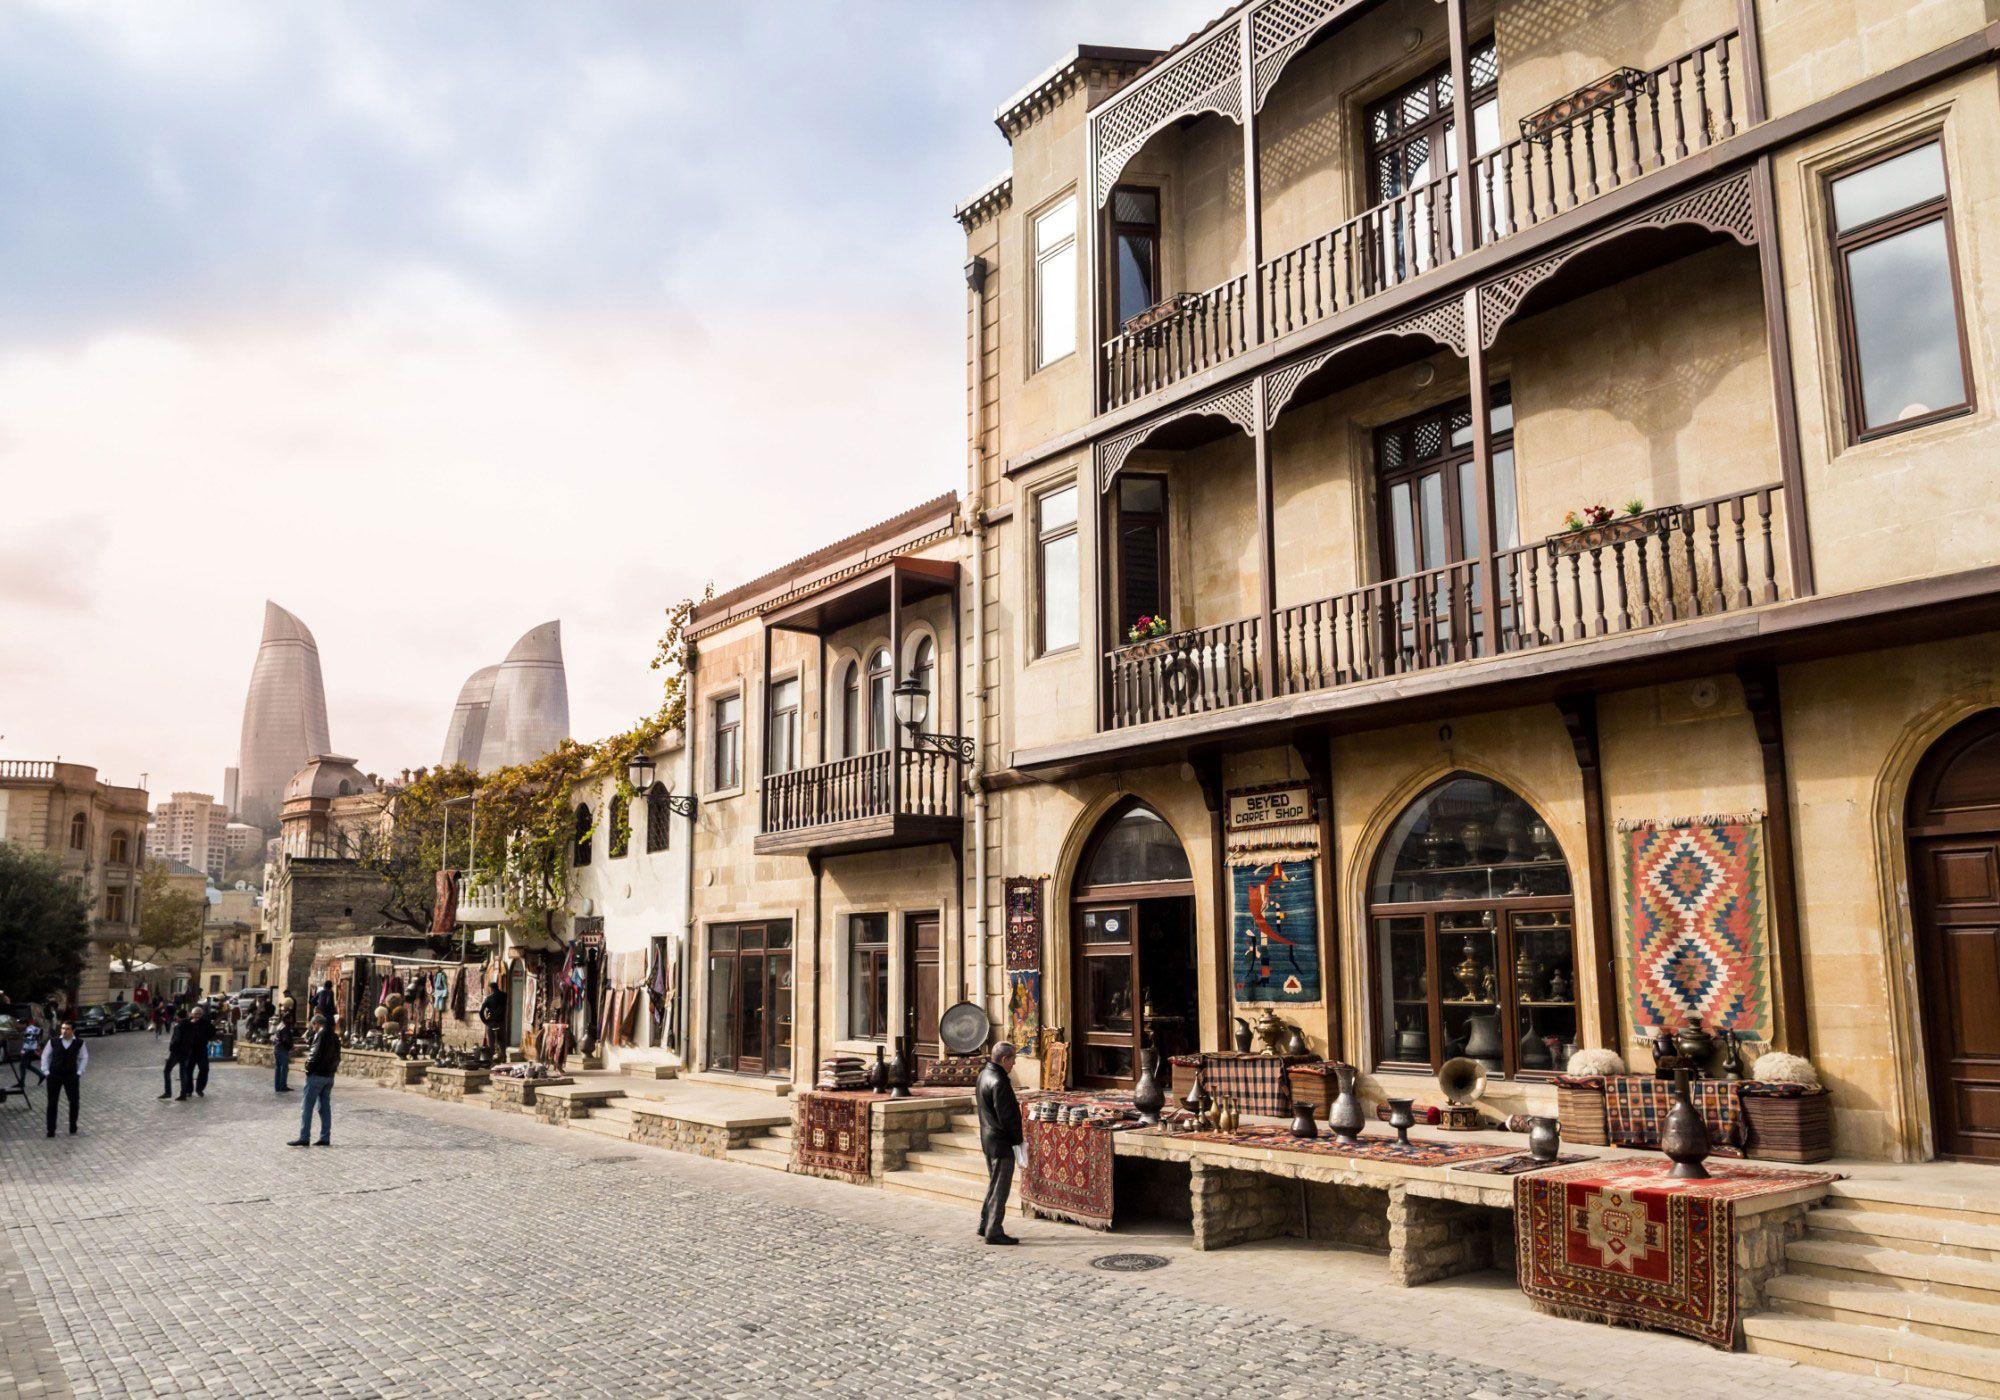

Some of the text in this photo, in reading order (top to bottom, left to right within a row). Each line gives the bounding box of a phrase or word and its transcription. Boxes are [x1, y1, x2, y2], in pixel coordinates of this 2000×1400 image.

[1247, 794, 1290, 810] SEYED
[1236, 806, 1303, 823] CARPET SHOP
